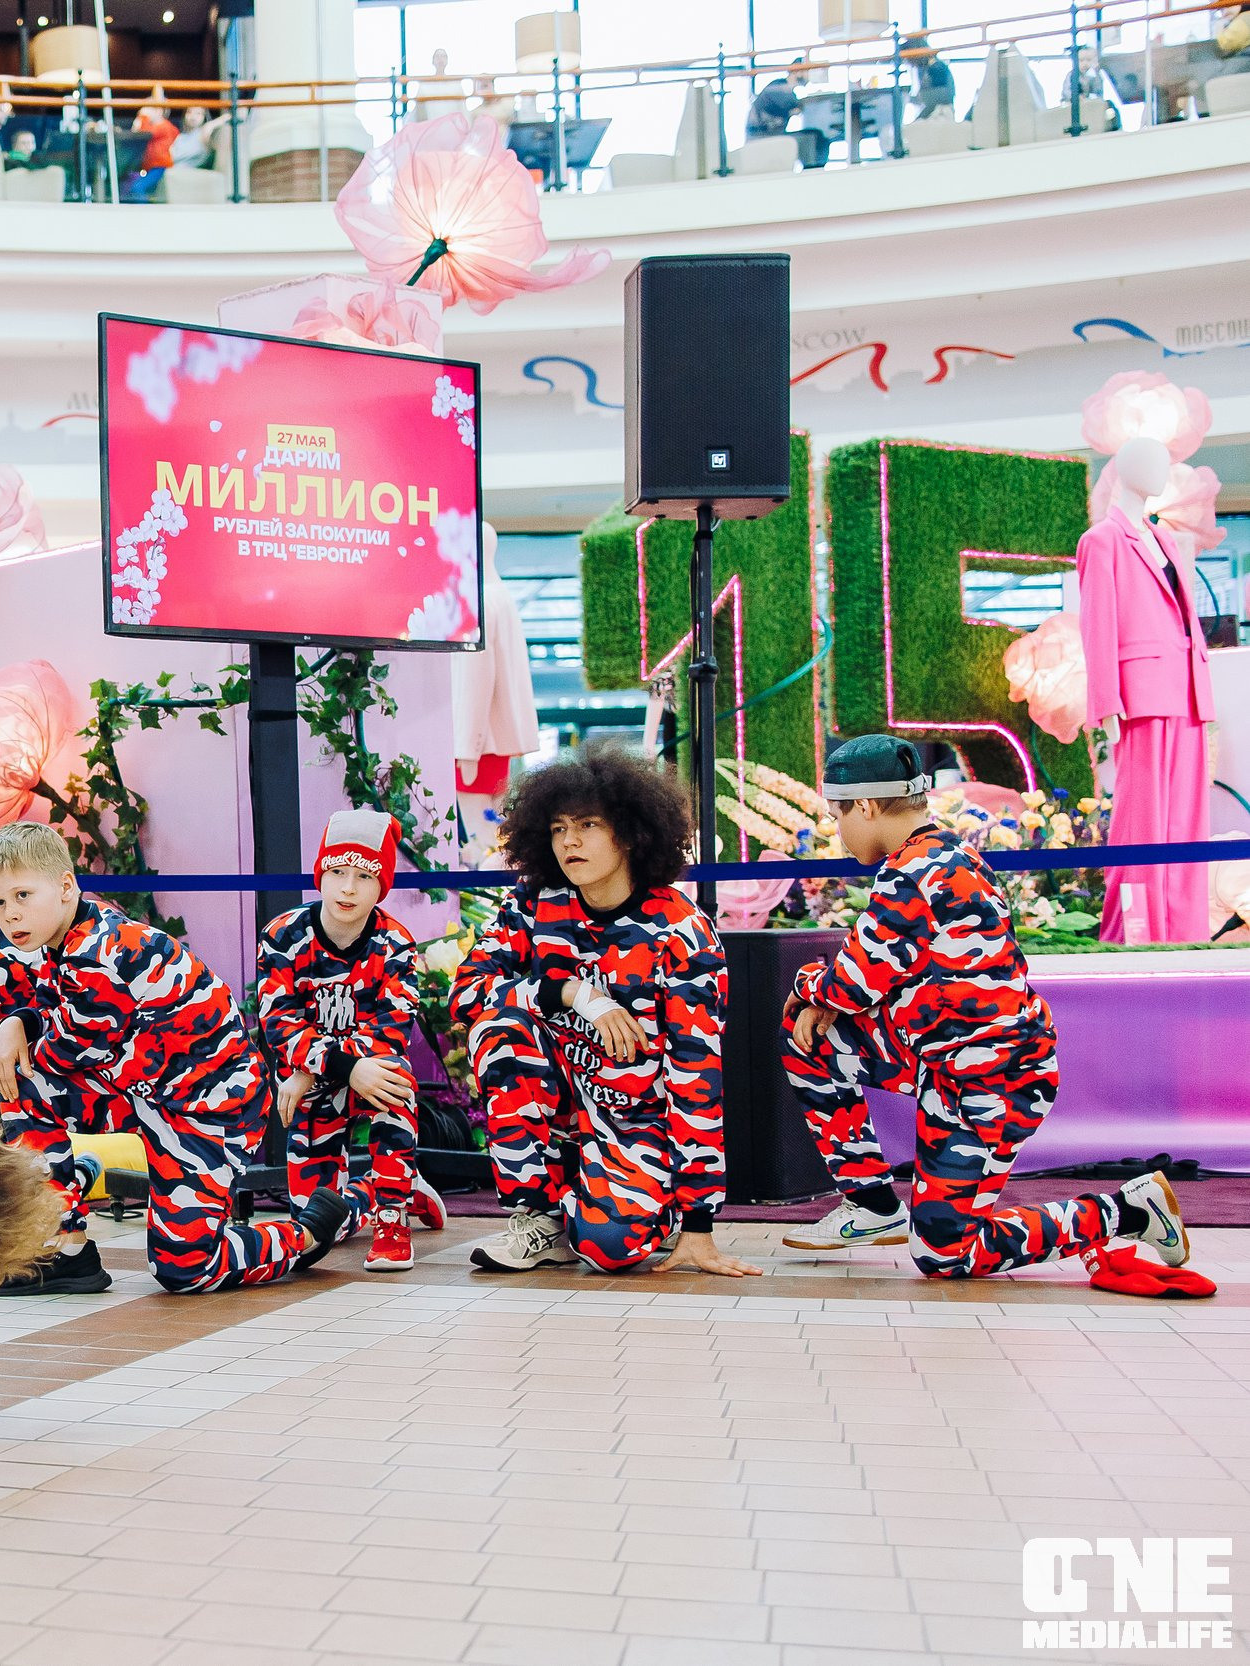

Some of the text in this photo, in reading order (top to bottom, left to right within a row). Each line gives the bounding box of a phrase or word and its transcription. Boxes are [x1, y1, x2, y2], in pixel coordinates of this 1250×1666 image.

[276, 431, 327, 448] 27 МАЯ
[262, 445, 342, 471] ДАРИМ
[155, 460, 439, 527] МИЛЛИОН
[213, 516, 390, 546] РУБЛЕЙ ЗА ПОКУПКИ
[237, 539, 251, 556] В
[251, 540, 288, 561] ТРЦ
[565, 1039, 602, 1076] city
